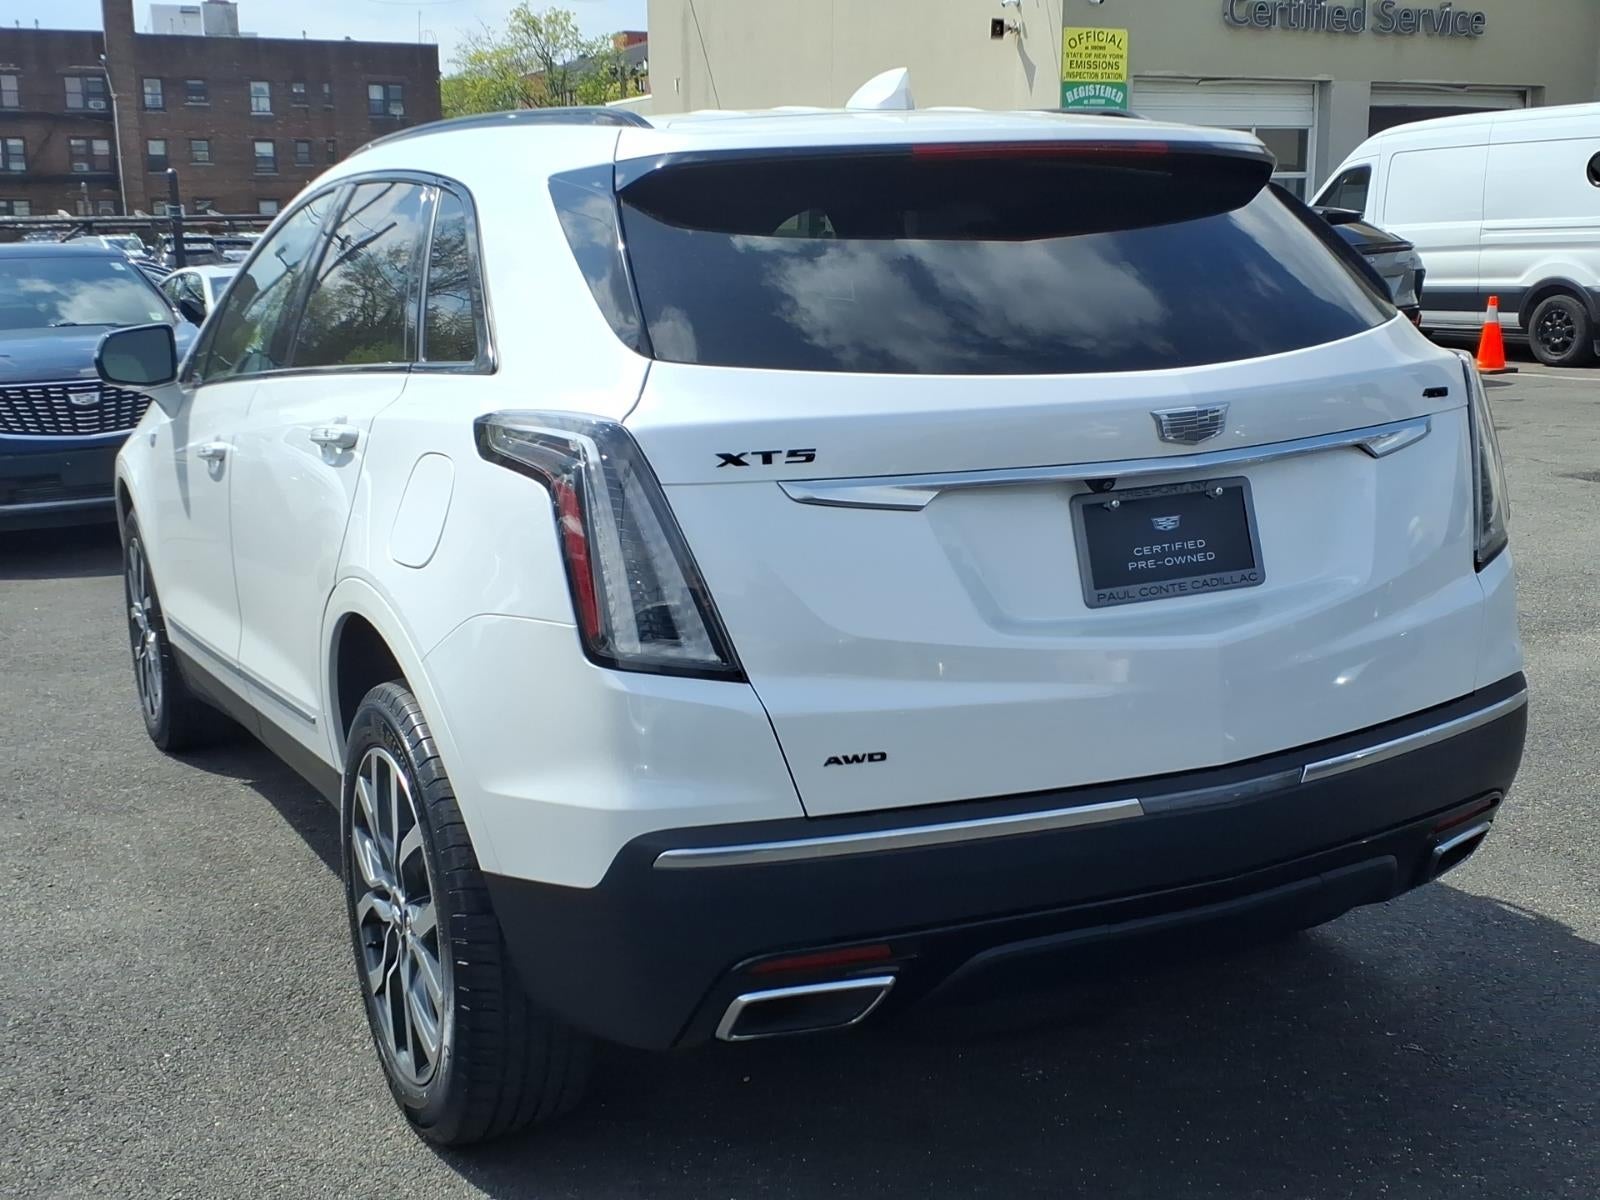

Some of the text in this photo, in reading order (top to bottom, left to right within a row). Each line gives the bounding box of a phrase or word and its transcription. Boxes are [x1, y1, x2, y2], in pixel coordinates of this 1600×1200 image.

[1223, 0, 1486, 37] Certified Service
[1068, 30, 1123, 50] OFFICIAL
[1069, 60, 1120, 70] EMISSIONS
[1065, 71, 1123, 81] INSPECTION STATION
[1065, 84, 1123, 103] REGISTERED
[714, 448, 817, 468] XT5
[1133, 539, 1207, 556] CERTIFIED
[1128, 551, 1217, 571] PRE-OWNED
[1096, 571, 1259, 603] PAUL CONTE CADILLAC
[823, 751, 887, 768] AWD
